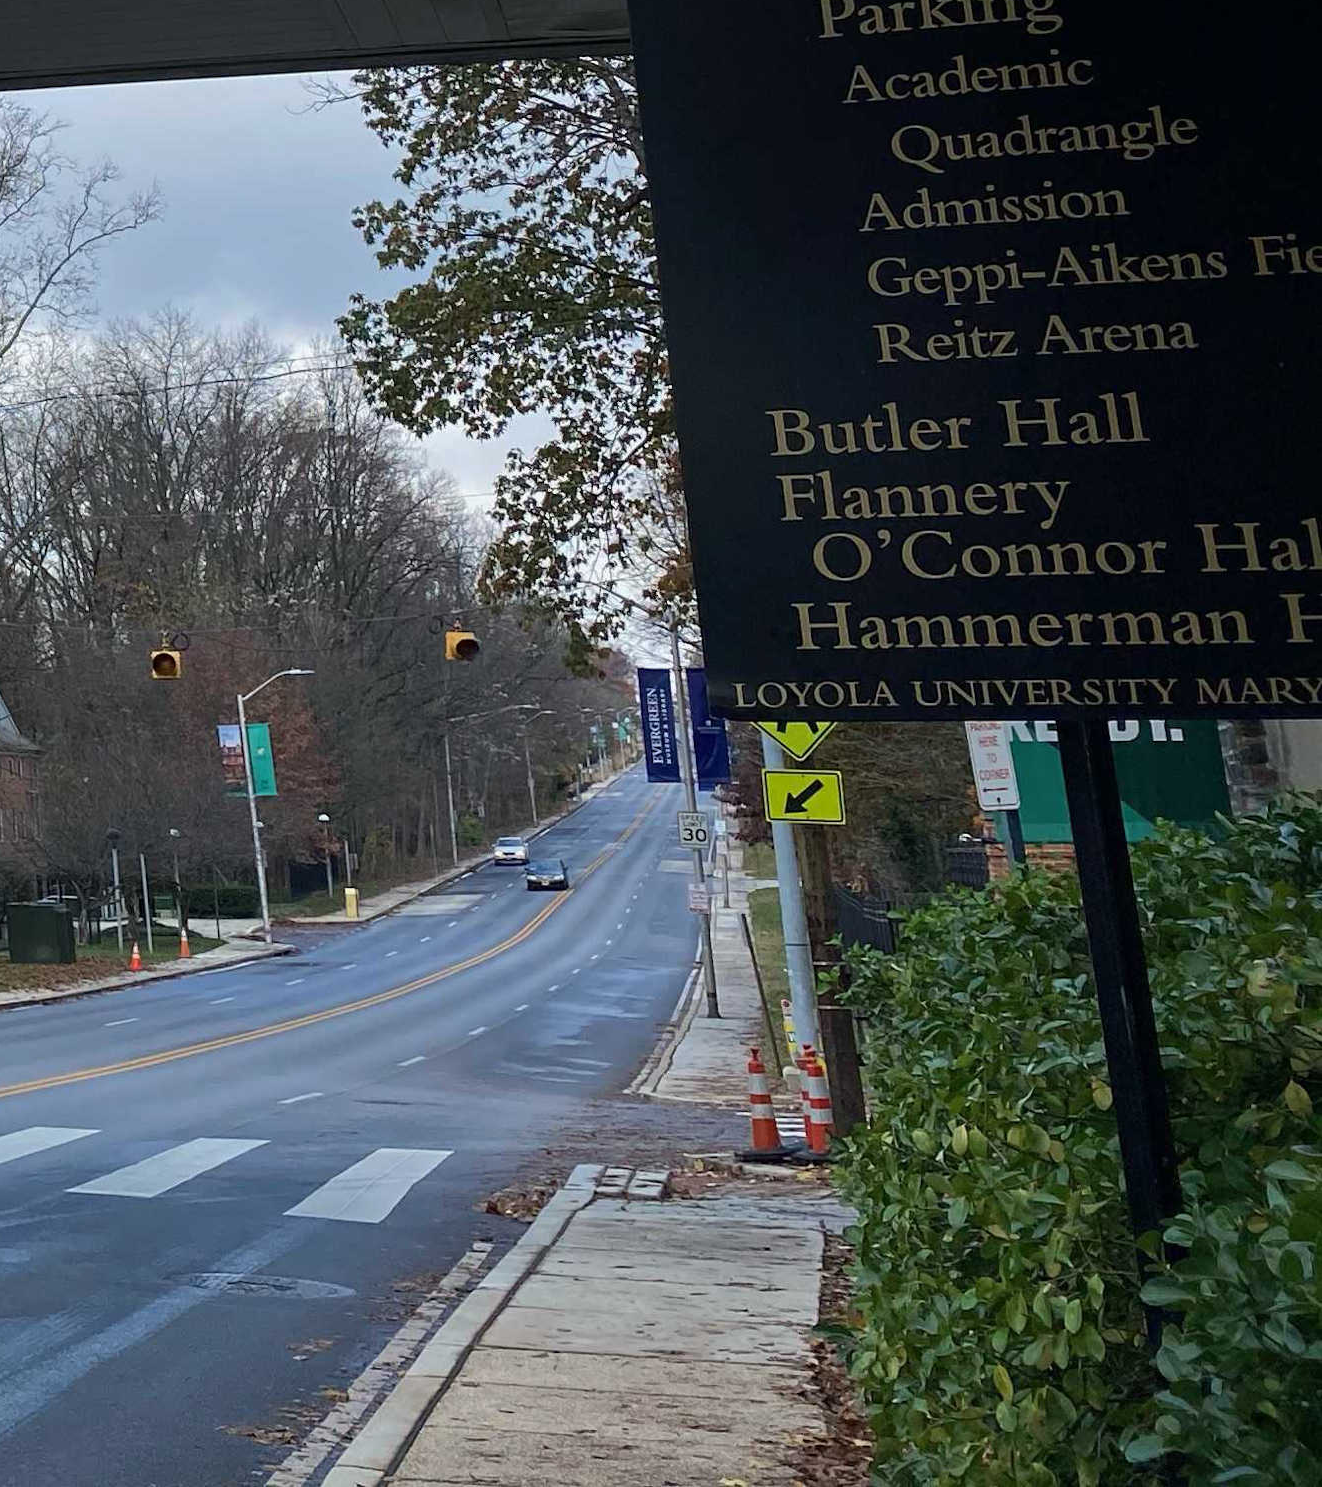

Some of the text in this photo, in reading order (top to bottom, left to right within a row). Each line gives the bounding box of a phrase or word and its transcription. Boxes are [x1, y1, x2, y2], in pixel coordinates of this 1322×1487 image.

[842, 49, 1093, 103] Academic
[891, 105, 1197, 173] Quadrangle
[859, 181, 1130, 232] Admission
[868, 243, 1227, 306] Geppi-Aikens
[872, 315, 1198, 362] Reitz Arena
[765, 392, 1150, 456] Butler Hall
[776, 470, 1070, 529] Flannery
[791, 602, 1255, 649] Hammerman
[732, 681, 899, 708] LOYOLA
[915, 679, 1177, 706] UNIVERSITY
[646, 687, 664, 765] EVERGREEN
[683, 827, 707, 843] 30
